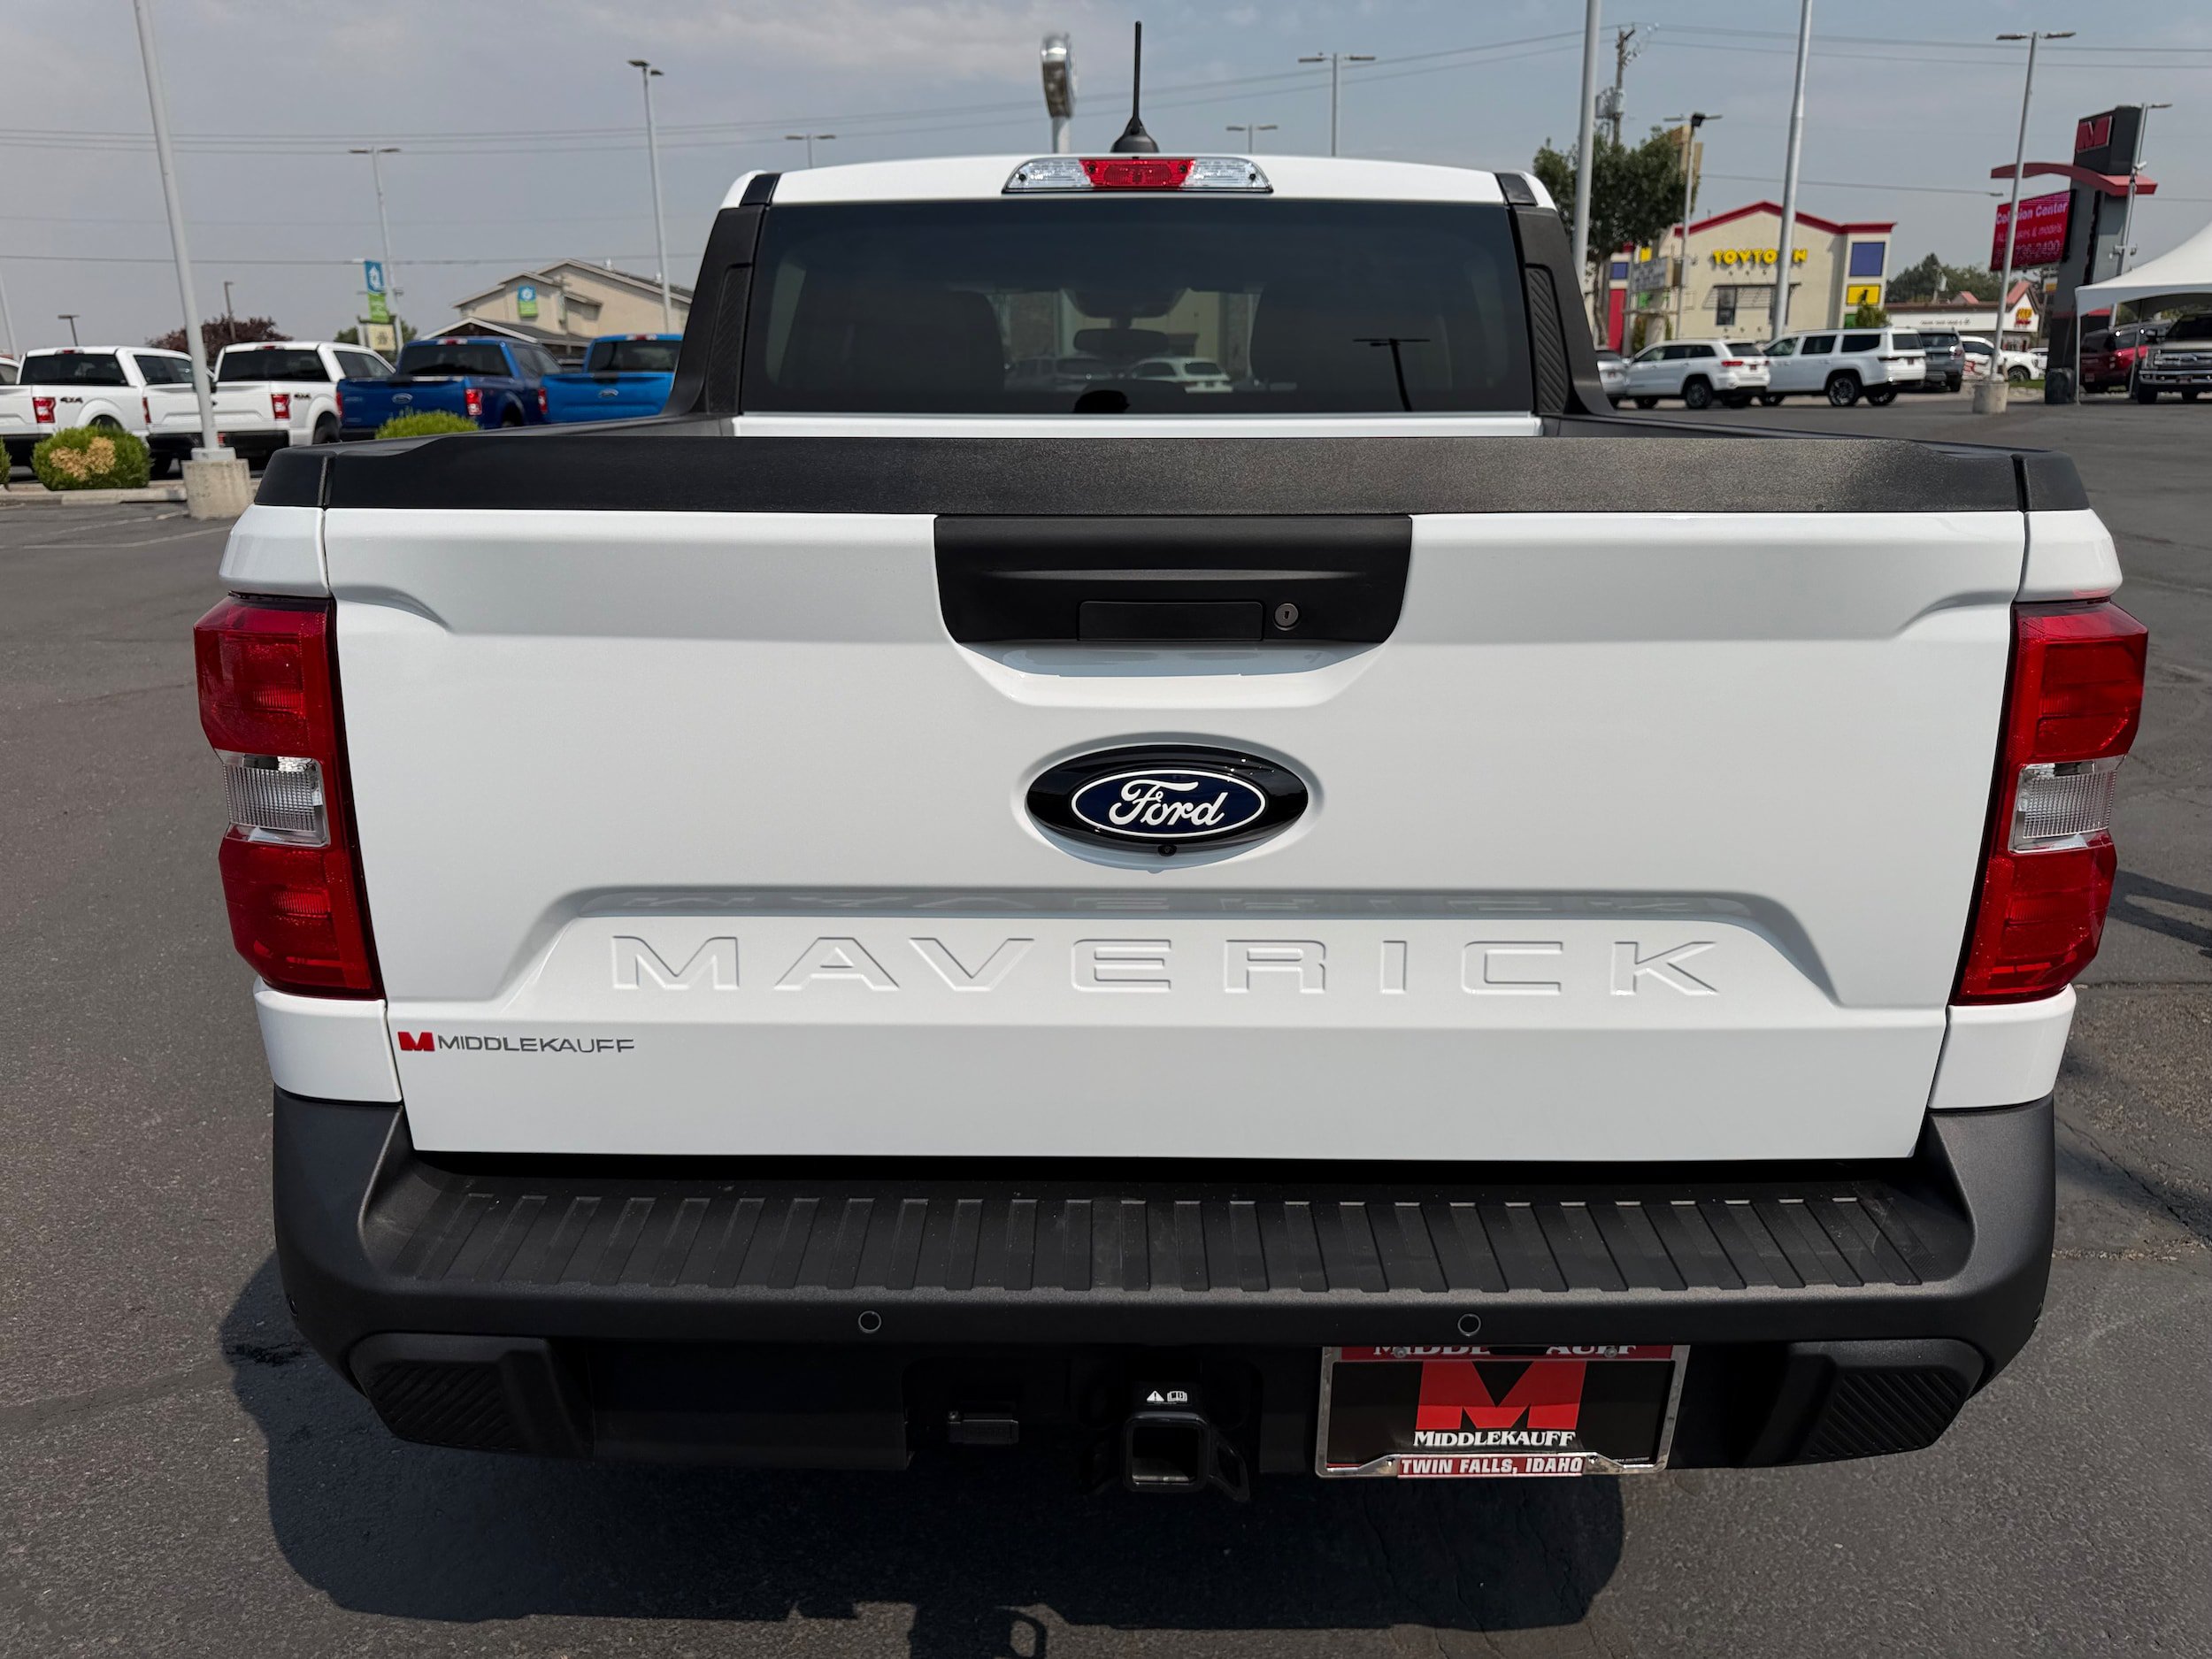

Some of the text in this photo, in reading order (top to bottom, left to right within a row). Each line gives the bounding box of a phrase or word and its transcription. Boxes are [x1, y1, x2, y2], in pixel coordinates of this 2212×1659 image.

[2035, 201, 2069, 218] Center
[1712, 248, 1808, 265] TOYTON
[1109, 779, 1229, 826] Ford
[611, 935, 1719, 996] MAVERICK
[437, 1033, 635, 1053] MIDDLEKAUFF
[1412, 1430, 1577, 1448] MIDDLEKAUFF
[1401, 1456, 1584, 1475] TWIN FALLS, IDAHO
